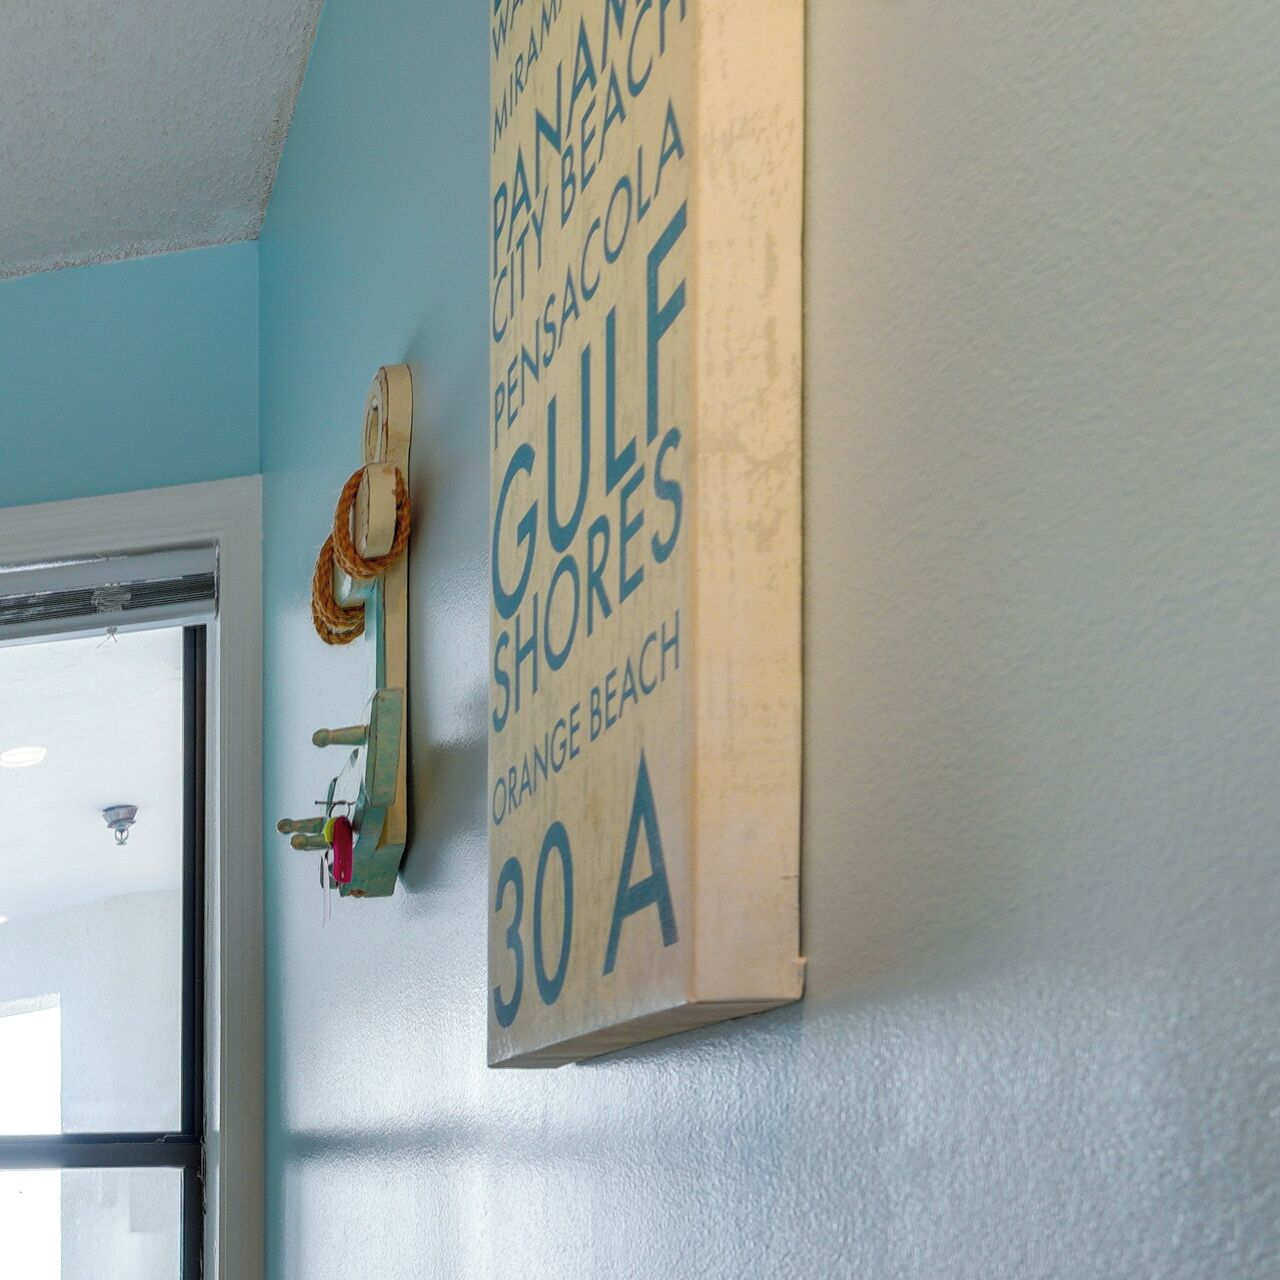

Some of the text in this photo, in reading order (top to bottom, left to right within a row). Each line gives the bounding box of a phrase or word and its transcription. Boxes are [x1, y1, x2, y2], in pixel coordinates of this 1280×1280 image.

[492, 183, 549, 344] CITY
[492, 201, 688, 620] GULF
[494, 96, 685, 450] PENSACOLA
[492, 426, 683, 733] SHORES
[492, 608, 680, 827] ORANGE BEACH
[493, 746, 680, 1029] 30 A
